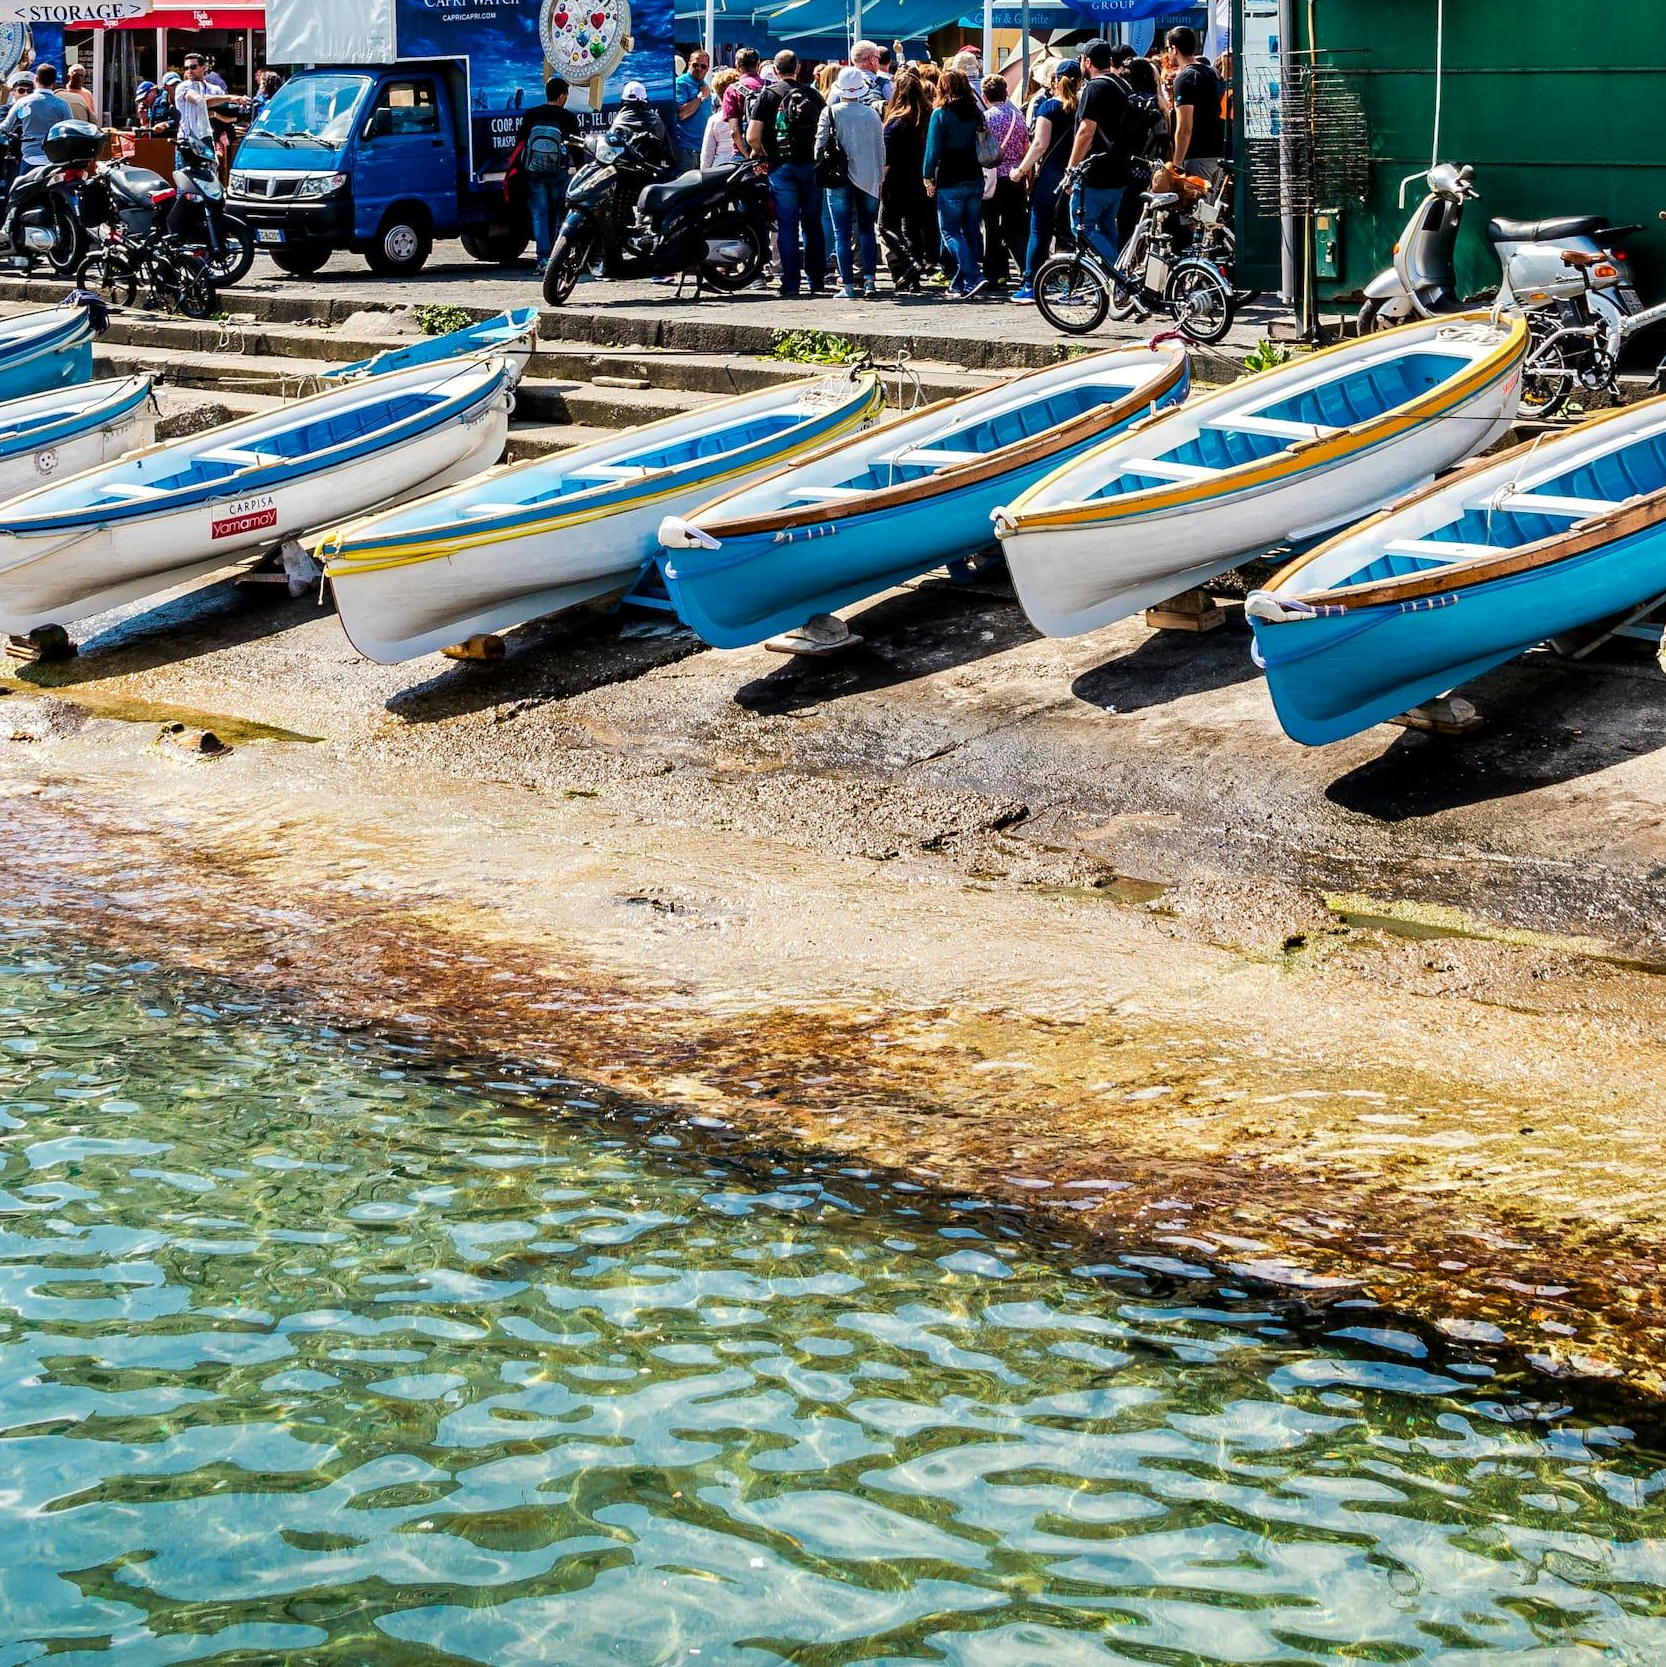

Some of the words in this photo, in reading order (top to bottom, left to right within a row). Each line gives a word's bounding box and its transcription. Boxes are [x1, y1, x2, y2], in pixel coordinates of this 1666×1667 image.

[1091, 0, 1135, 11] GROUP
[442, 13, 497, 22] CAPRICAPRI.COM
[1003, 12, 1015, 25] &
[492, 118, 515, 133] COOP.
[591, 111, 607, 126] TEL.
[493, 136, 517, 148] TRASPO
[229, 496, 274, 515] CARPISA
[213, 510, 277, 538] yamamay
